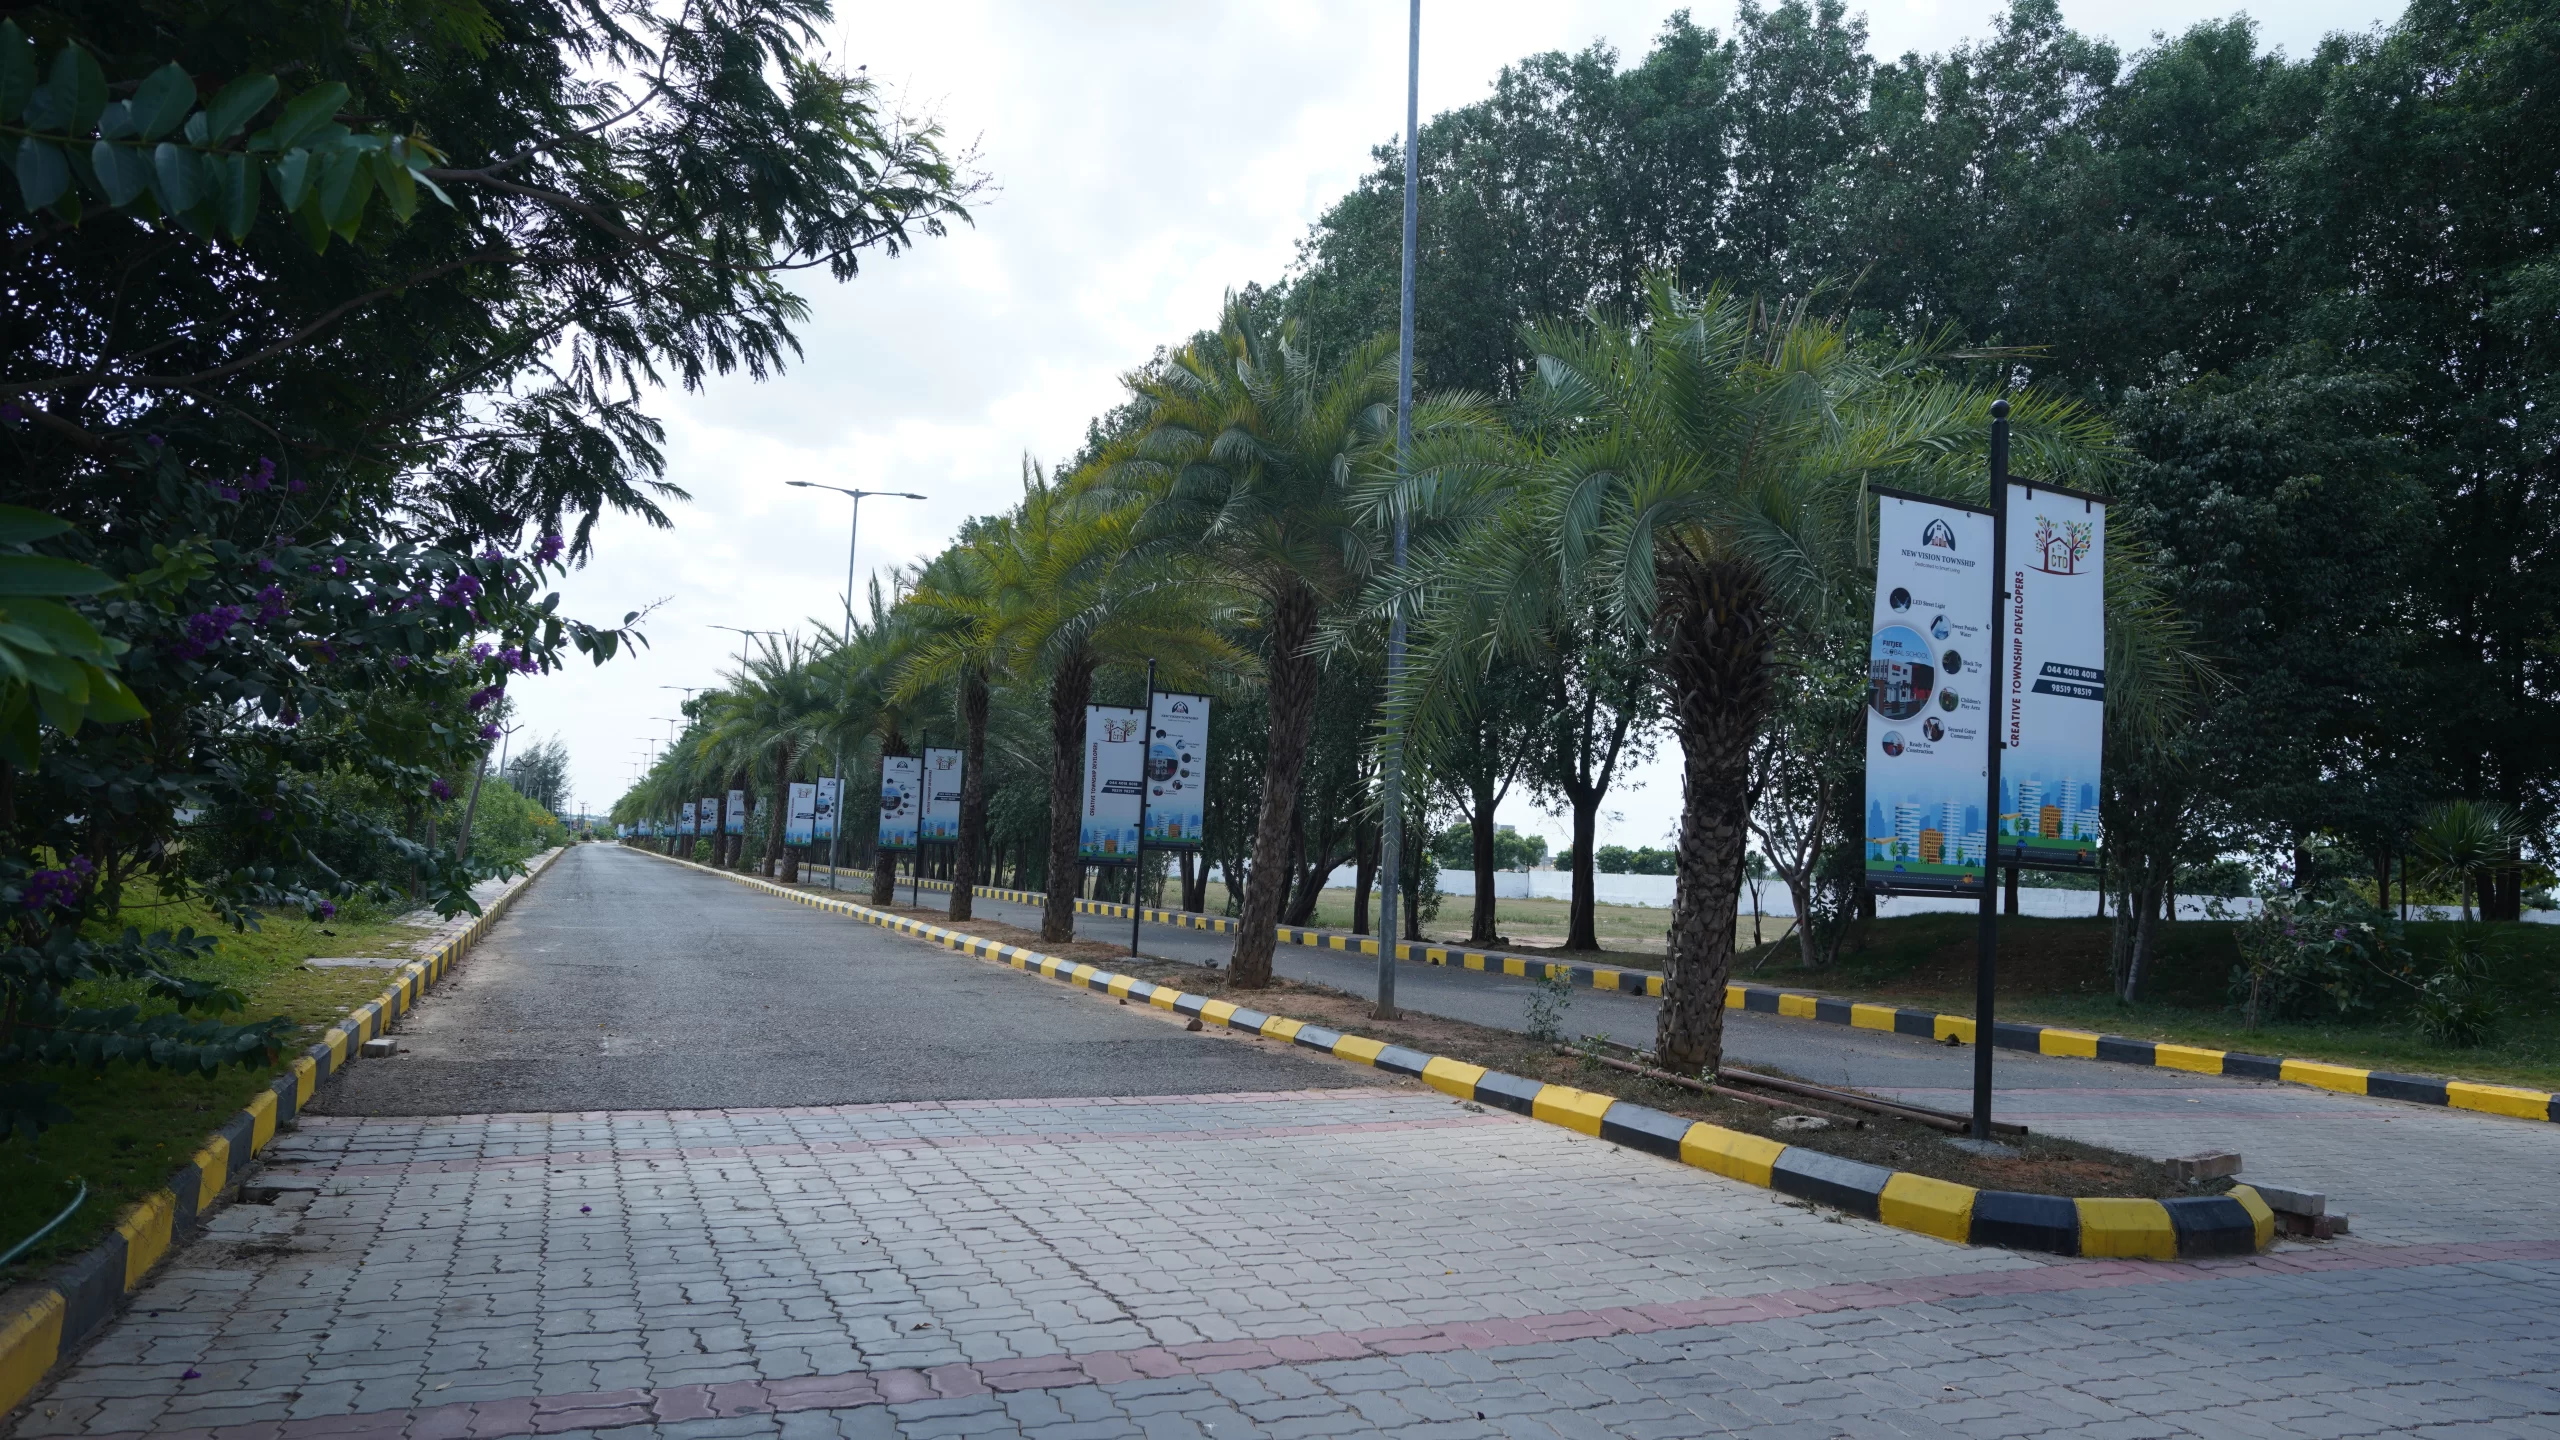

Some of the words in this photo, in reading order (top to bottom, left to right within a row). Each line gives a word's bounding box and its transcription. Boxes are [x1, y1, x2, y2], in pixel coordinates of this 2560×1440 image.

[1901, 549, 1917, 557] NEW
[1918, 551, 1940, 561] VISION
[1941, 555, 1976, 567] TOWNSHIP
[1914, 561, 1935, 569] Dedicated
[2051, 554, 2068, 568] CTD
[2014, 571, 2024, 634] DEVELOPERS
[1905, 651, 1929, 659] SCHOOL
[2012, 638, 2023, 694] TOWNSHIP
[2047, 665, 2061, 674] 044
[2063, 668, 2079, 677] 4018
[2081, 670, 2097, 679] 4018
[2051, 684, 2071, 693] 98519
[2073, 687, 2092, 696] 98519
[2010, 698, 2021, 747] CREATIVE
